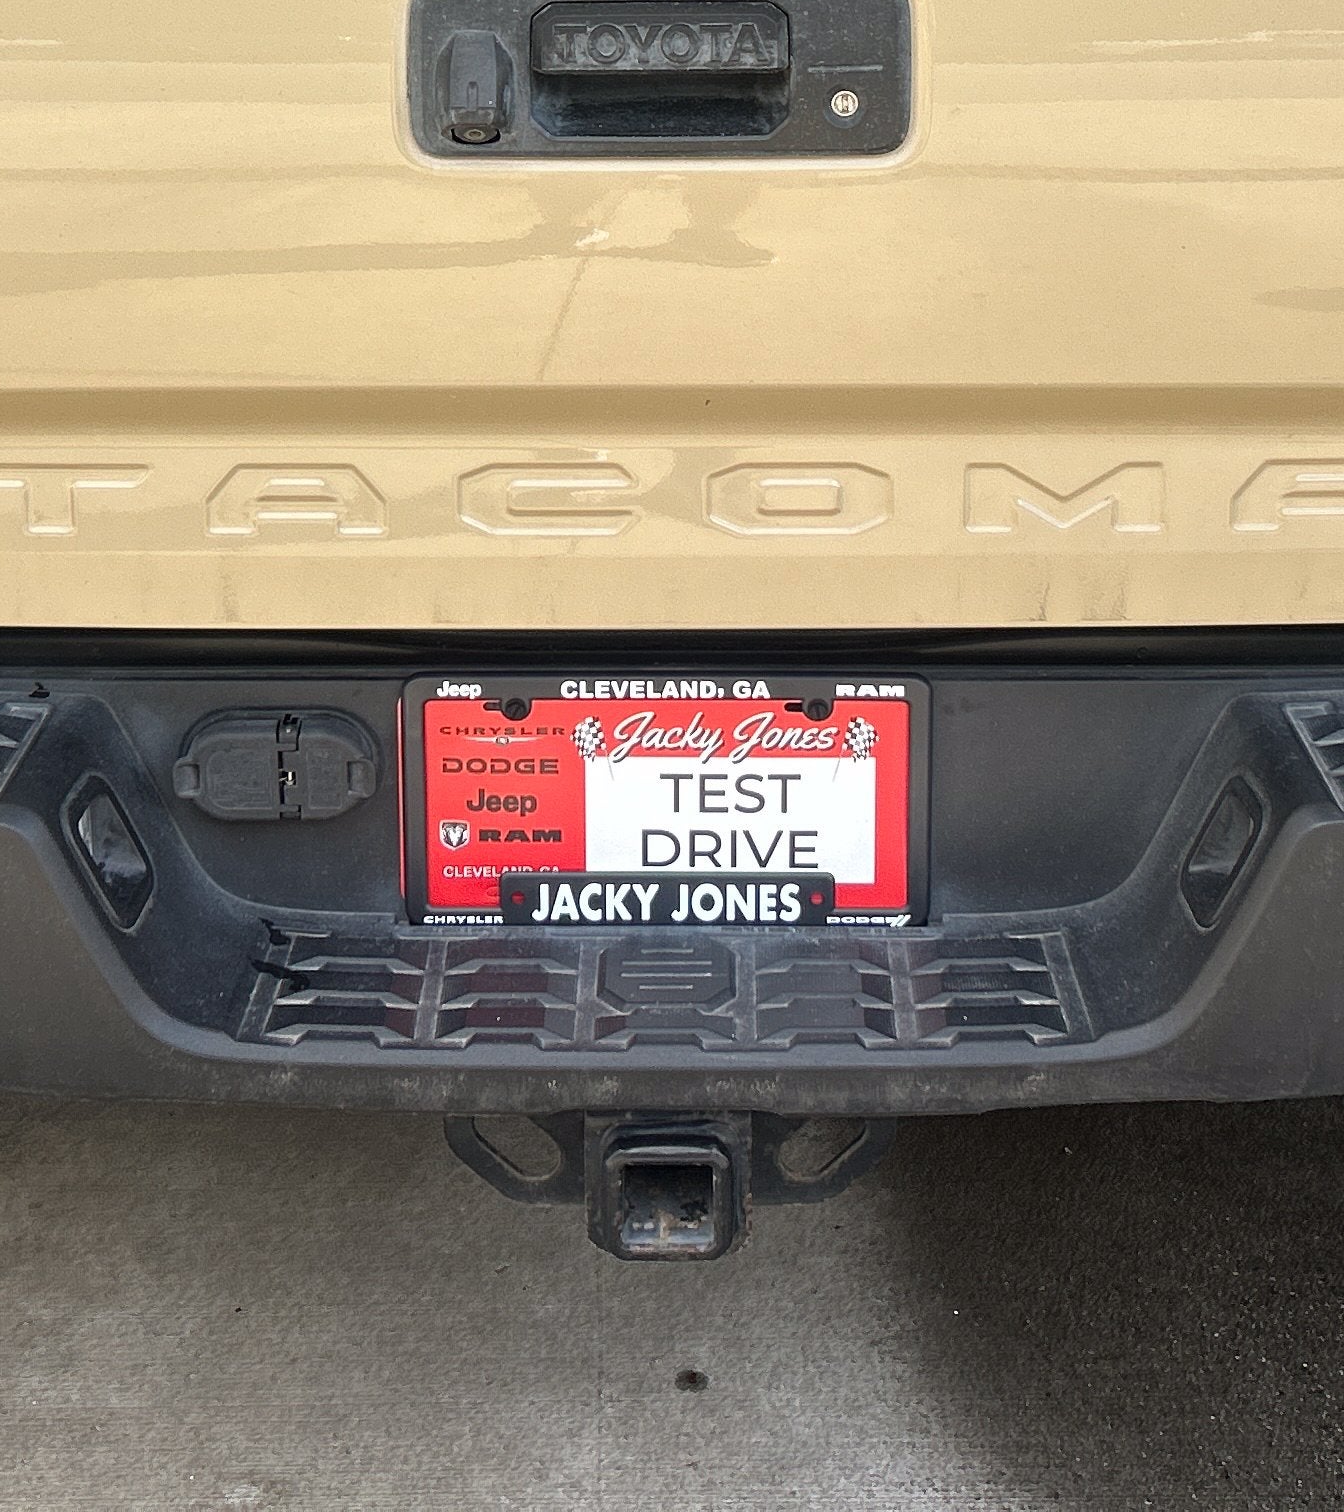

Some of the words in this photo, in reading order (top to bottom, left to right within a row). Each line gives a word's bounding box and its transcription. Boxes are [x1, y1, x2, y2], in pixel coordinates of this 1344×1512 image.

[555, 23, 772, 65] TOYOTA
[437, 681, 482, 699] Jeep
[560, 681, 725, 699] CLEVELAND,
[732, 681, 771, 699] GA
[836, 684, 906, 698] RAM
[439, 726, 565, 736] CHRYSLER
[612, 711, 724, 764] Jacky
[728, 711, 840, 764] Jones
[442, 757, 559, 775] DODGE
[659, 773, 802, 814] TEST
[467, 789, 538, 817] Jeep
[478, 828, 563, 843] RAM
[641, 829, 818, 869] DRIVE
[531, 882, 660, 922] JACKY
[670, 882, 802, 922] JONES
[423, 915, 504, 924] CHRYSLER
